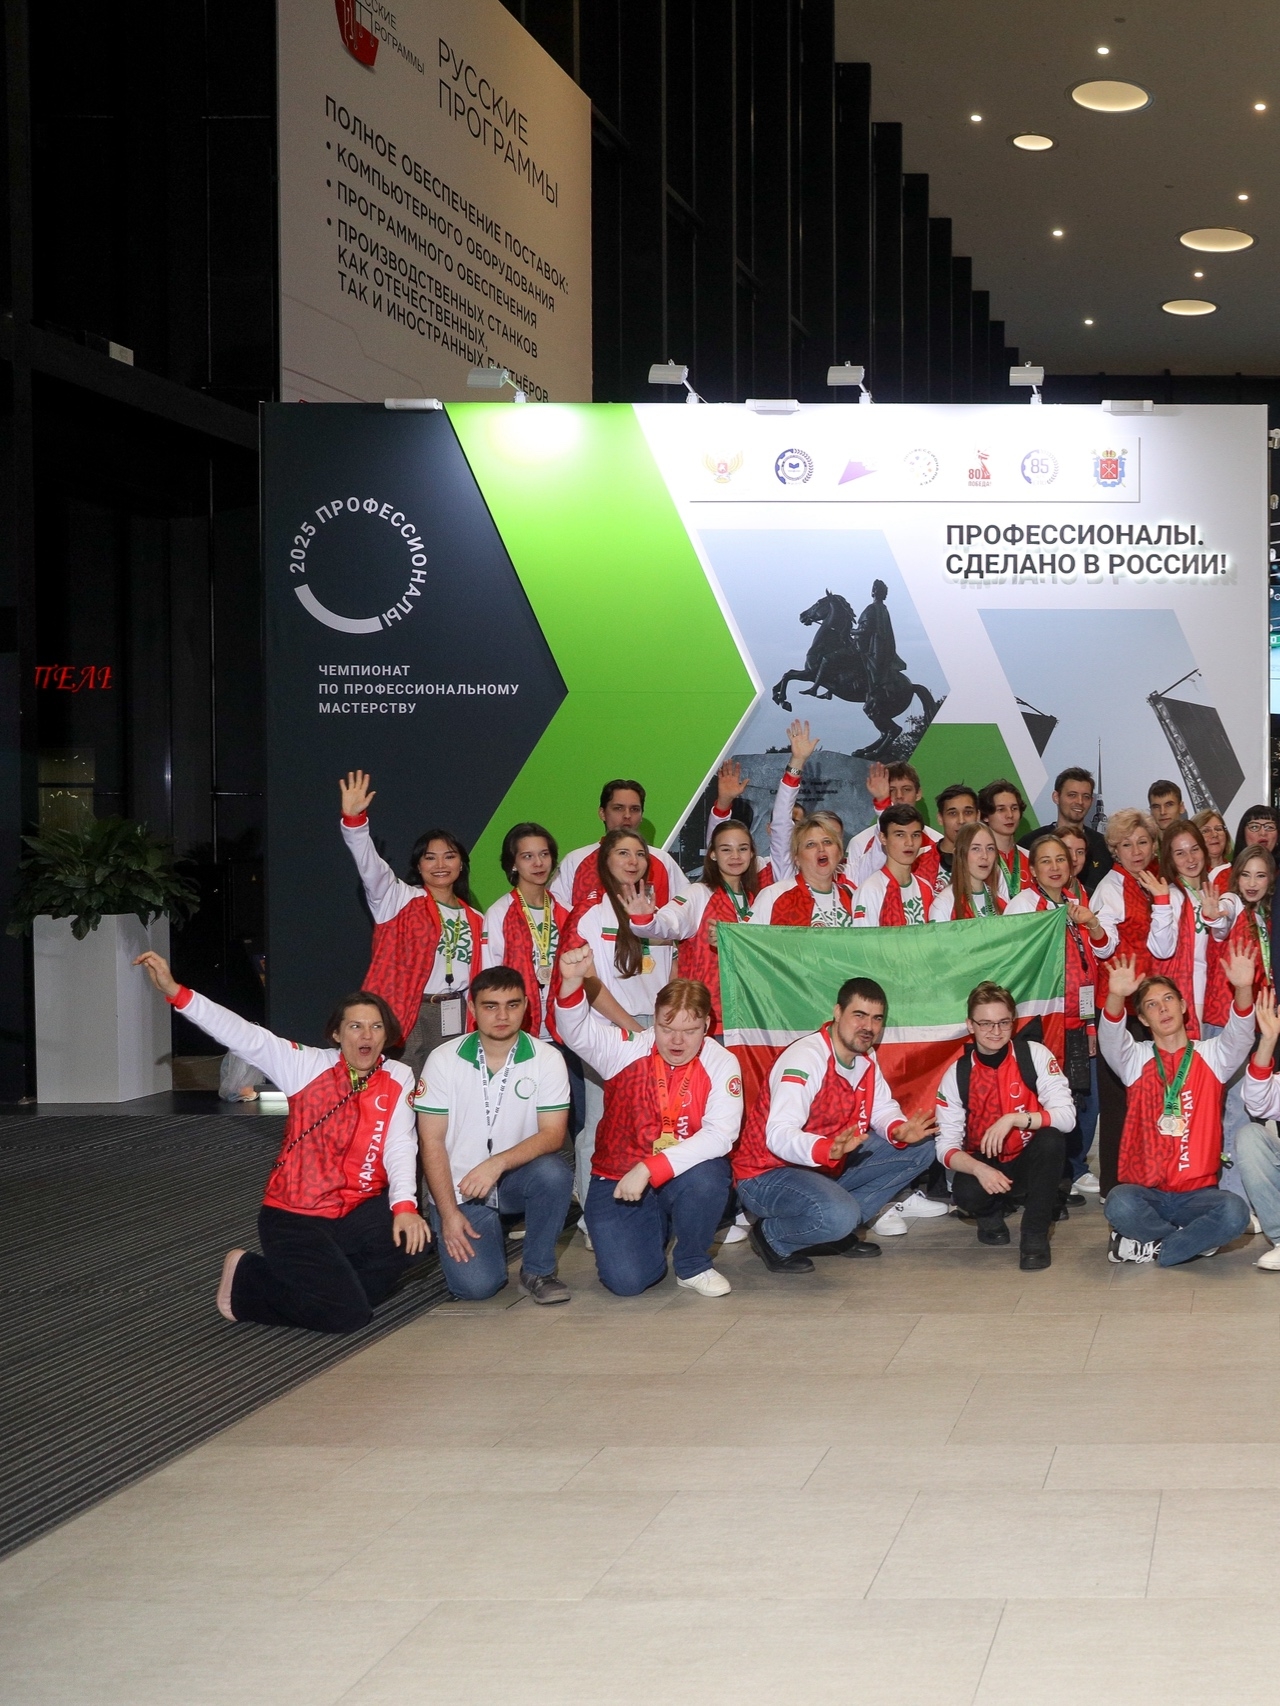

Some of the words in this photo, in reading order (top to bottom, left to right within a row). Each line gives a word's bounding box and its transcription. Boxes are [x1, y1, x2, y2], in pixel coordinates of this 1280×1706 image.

[438, 37, 528, 146] РУССКИЕ
[438, 79, 558, 207] ПРОГРАММЫ
[325, 95, 397, 166] ПОЛНОЕ
[402, 154, 501, 244] ОБЕСПЕЧЕНИЕ
[504, 232, 569, 295] ПОСТАВОК:
[337, 143, 463, 246] КОМПЬЮТЕРНОГО
[466, 237, 555, 312] ОБОРУДОВАНИЯ
[337, 180, 454, 273] ПРОГРАММНОГО
[457, 263, 537, 329] ОБЕСПЕЧЕНИЯ
[337, 218, 484, 325] ПРОИЗВОДСТВЕННЫХ
[487, 314, 538, 359] СТАНКОВ
[337, 245, 370, 280] КАК
[373, 268, 488, 351] ОТЕЧЕСТВЕННЫХ,
[337, 271, 369, 305] ТАК
[372, 290, 382, 313] И
[387, 295, 484, 369] ИНОСТРАННЫХ
[968, 468, 981, 480] 80
[1031, 458, 1049, 474] 85
[289, 521, 317, 575] 2025
[314, 496, 428, 628] ПРОФЕССИОНАЛЫ
[945, 524, 1205, 547] ПРОФЕССИОНАЛЫ.
[945, 553, 1076, 579] СДЕЛАНО
[1083, 553, 1100, 575] В
[1108, 553, 1229, 575] РОССИИ!
[318, 664, 411, 677] ЧЕМПИОНАТ
[318, 683, 340, 696] ПО
[344, 683, 520, 696] ПРОФЕССИОНАЛЬНОМУ
[318, 702, 417, 715] МАСТЕРСТВУ
